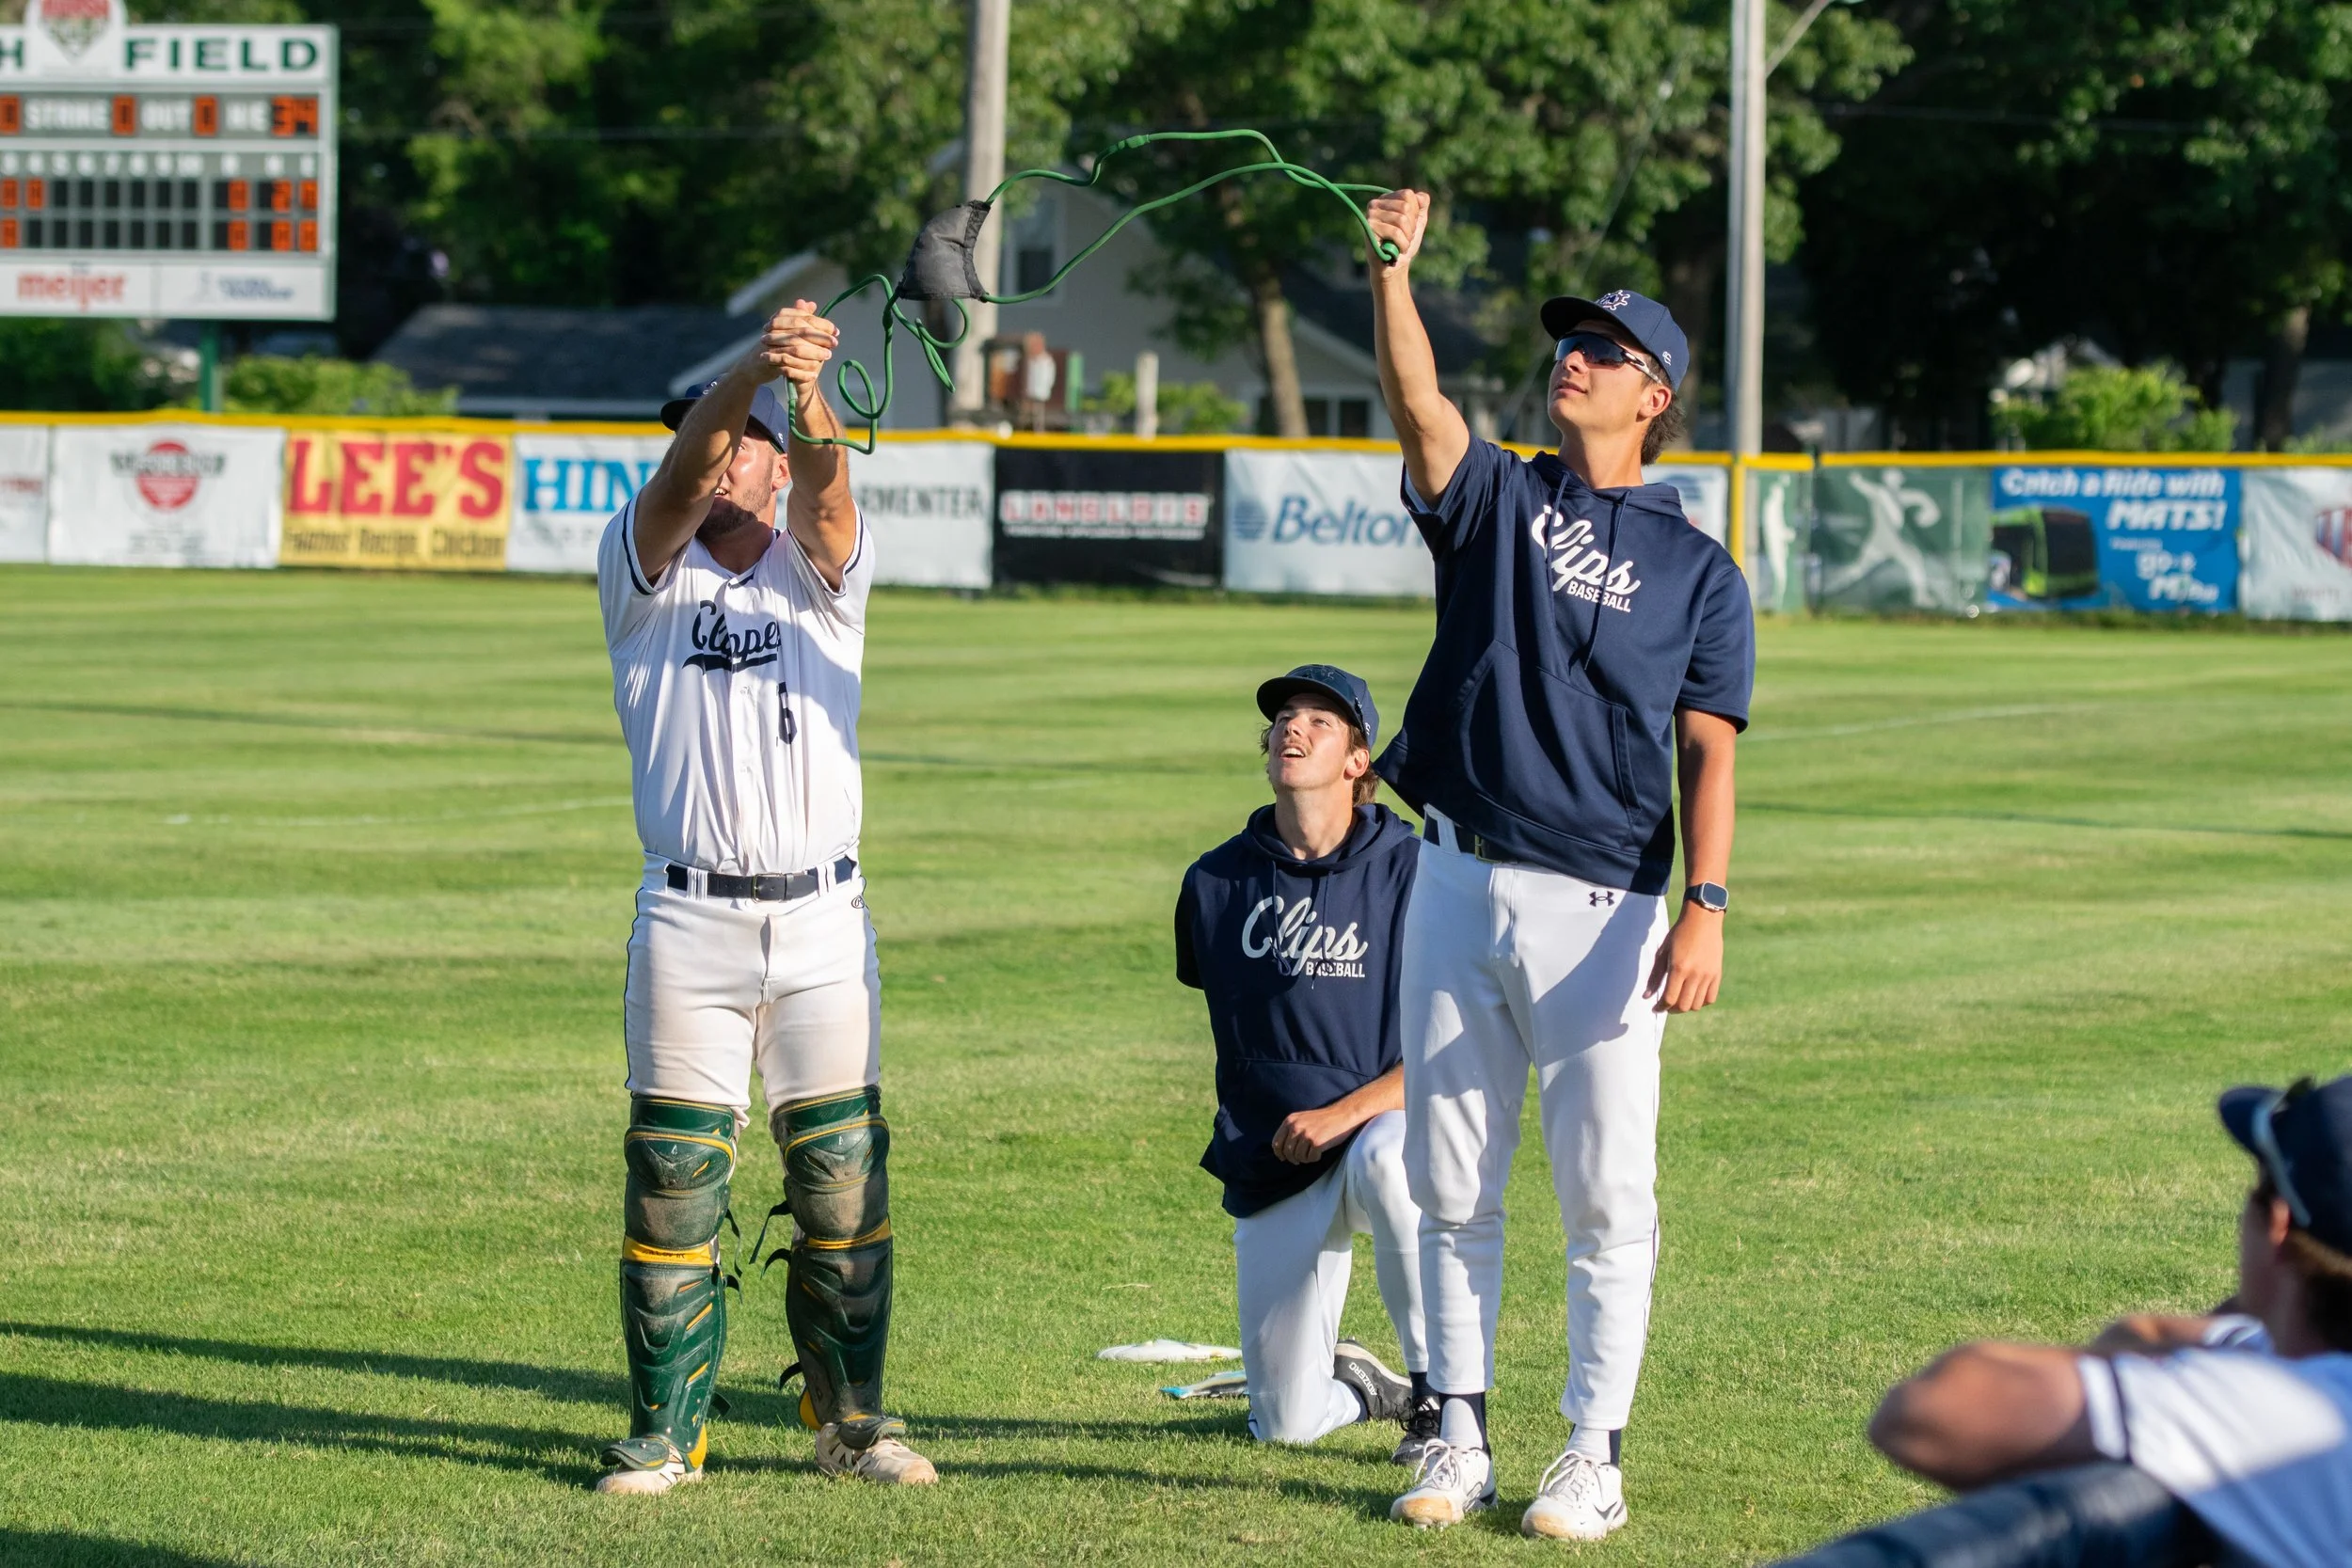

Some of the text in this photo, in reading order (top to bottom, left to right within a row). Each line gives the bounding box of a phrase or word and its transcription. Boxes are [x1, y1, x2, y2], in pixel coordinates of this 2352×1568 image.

[124, 37, 319, 71] FIELD
[17, 273, 127, 312] meijer
[290, 439, 504, 517] LEE'S
[2000, 468, 2226, 498] Catch a Ride with
[2106, 499, 2228, 531] MATS!
[1532, 504, 1642, 595] Clips
[1566, 579, 1631, 612] BASEBALL
[1242, 895, 1369, 976] Clips
[1306, 961, 1366, 978] BASEBALL
[1348, 1362, 1378, 1396] ADIZERO
